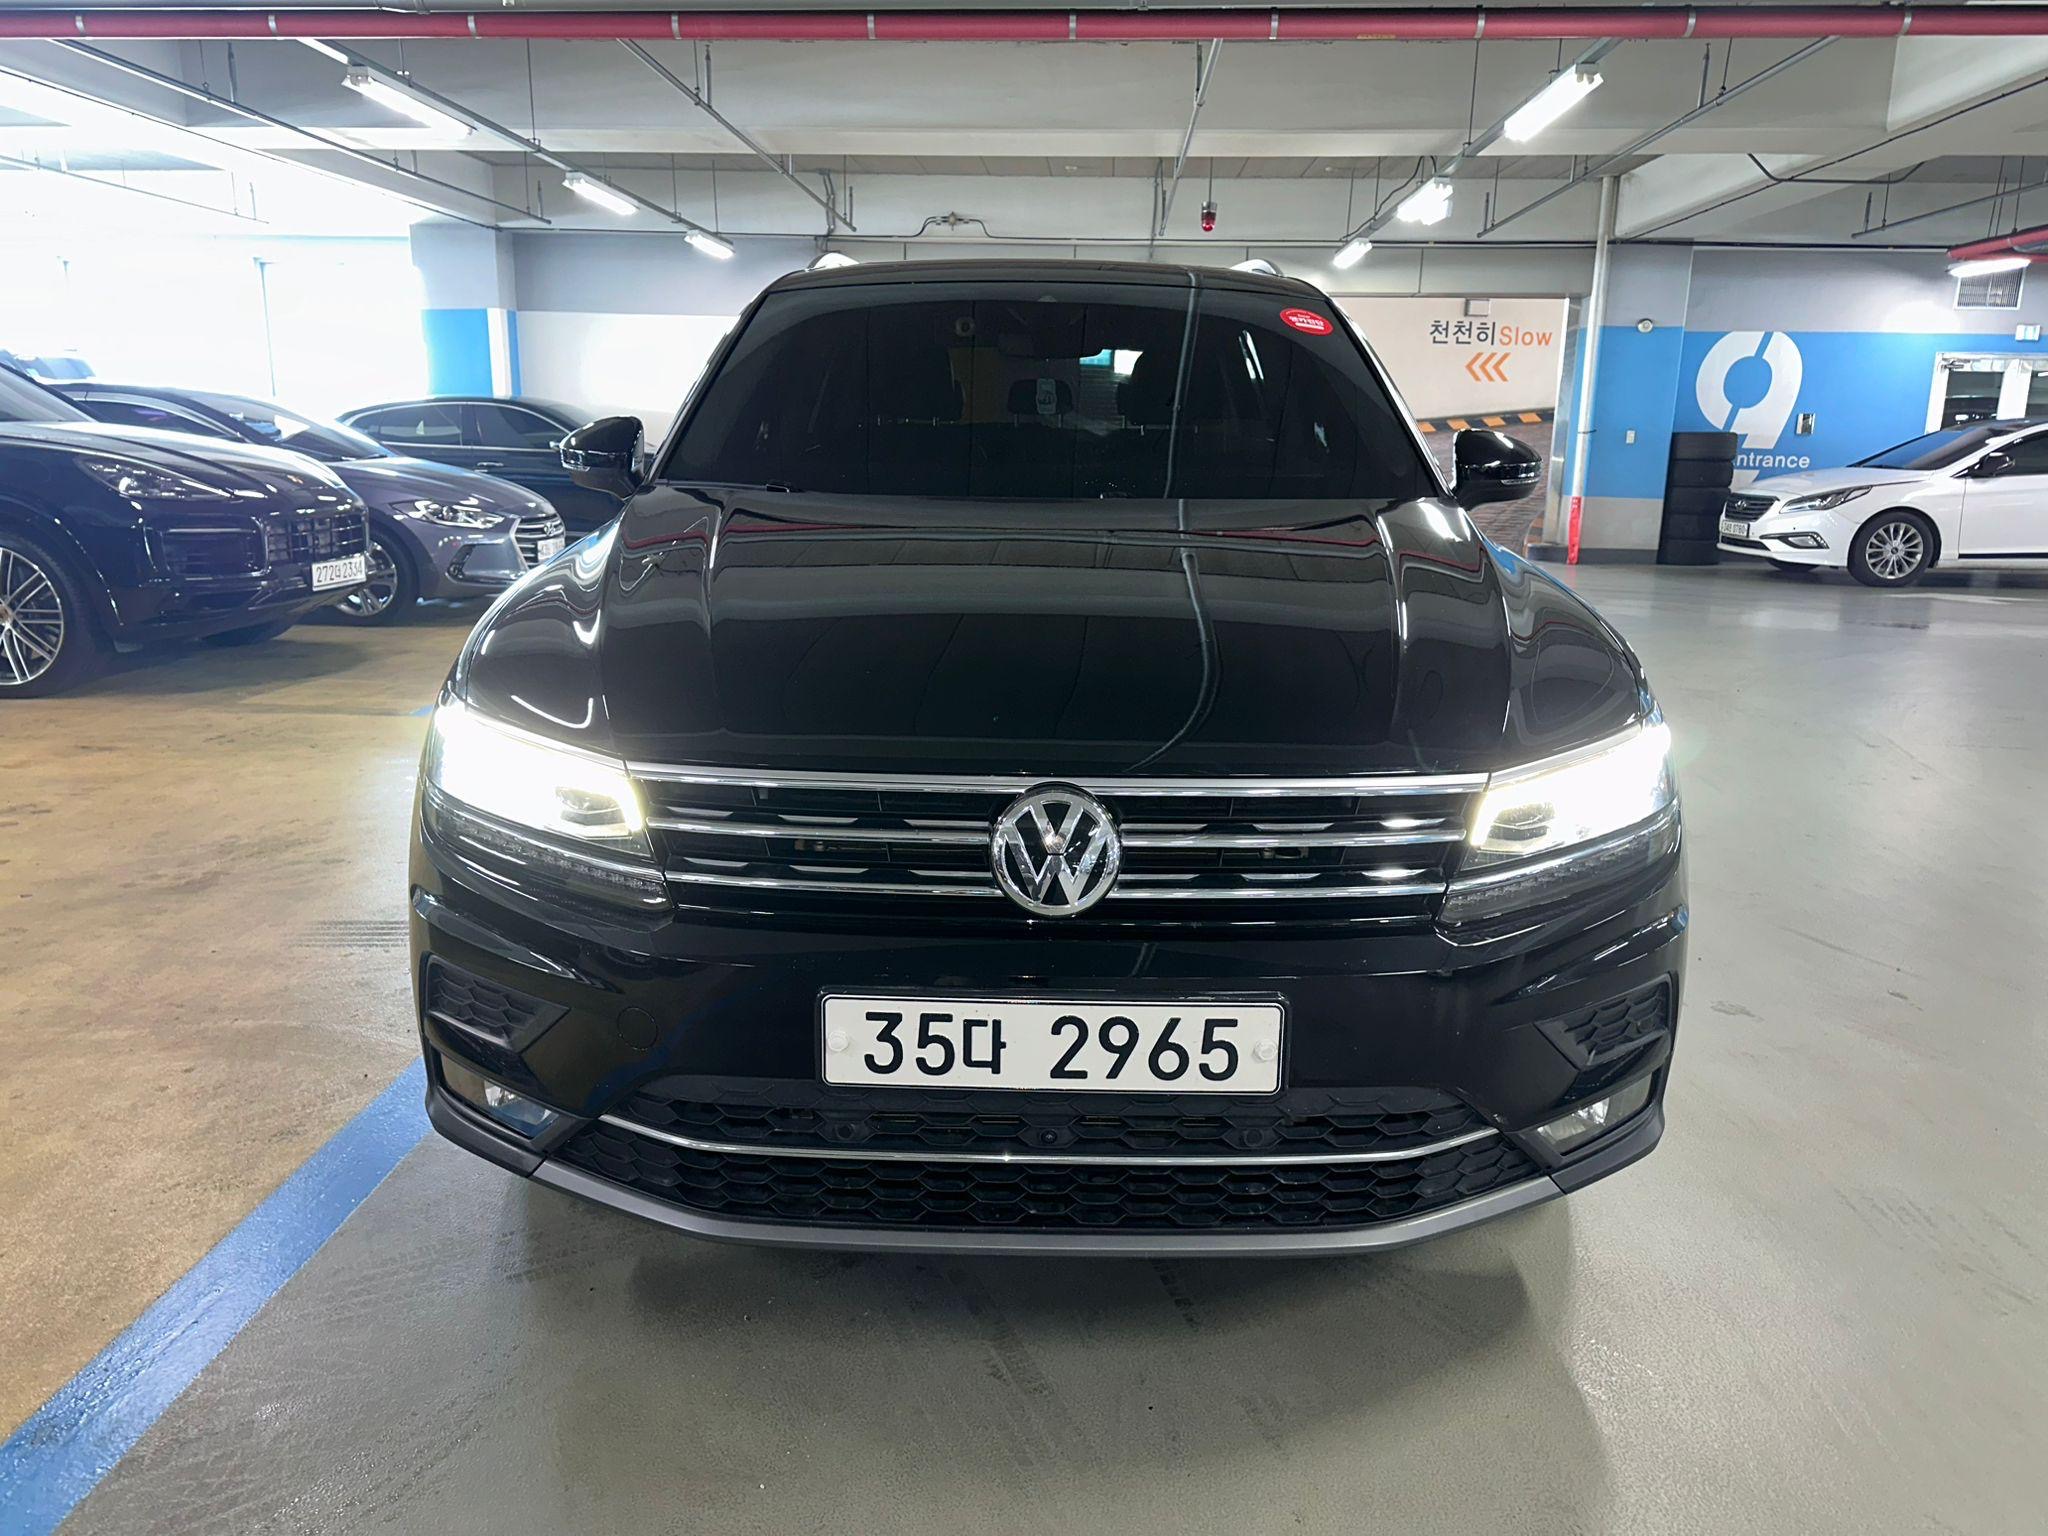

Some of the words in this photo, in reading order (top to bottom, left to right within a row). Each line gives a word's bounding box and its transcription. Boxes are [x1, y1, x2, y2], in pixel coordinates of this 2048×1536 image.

[1429, 320, 1496, 346] 천천히
[1499, 325, 1553, 346] Slow
[1695, 331, 1803, 486] 9
[1732, 452, 1810, 469] ntrance
[863, 1011, 1007, 1076] 35다
[1049, 1015, 1240, 1082] 2965
